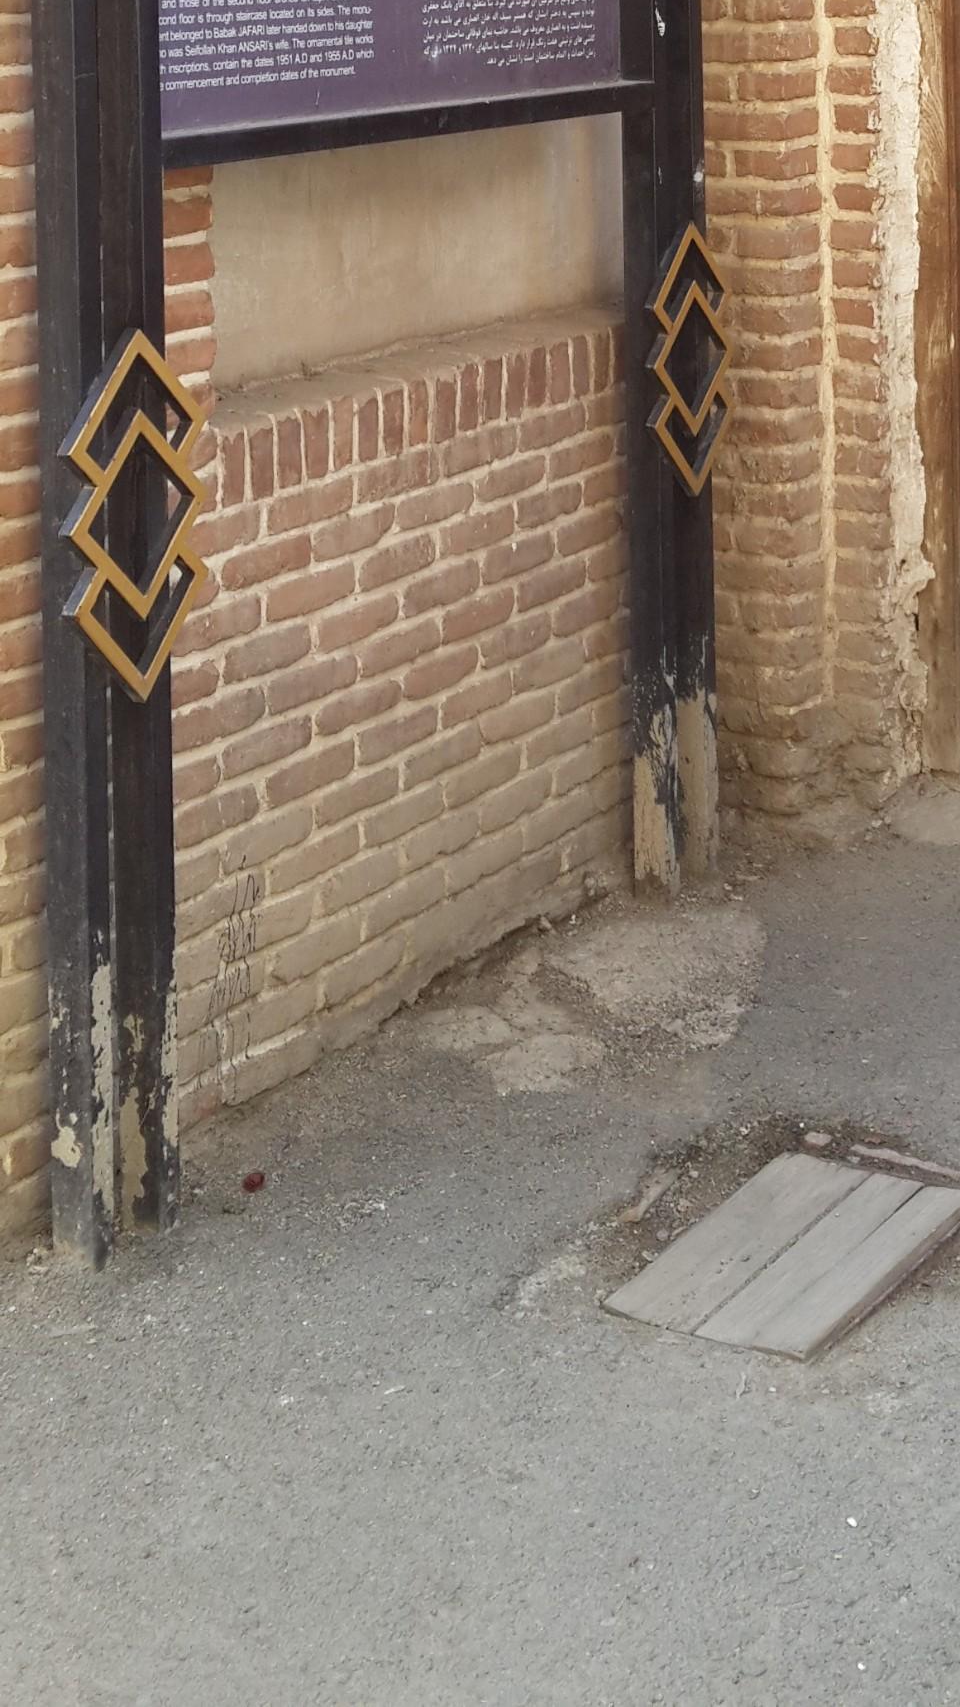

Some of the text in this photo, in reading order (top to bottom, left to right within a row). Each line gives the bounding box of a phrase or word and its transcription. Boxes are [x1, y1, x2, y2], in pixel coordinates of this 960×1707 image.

[159, 14, 176, 25] cond
[179, 14, 196, 24] floor
[206, 12, 234, 25] through
[236, 10, 267, 21] staircase
[269, 8, 294, 19] located
[296, 9, 305, 18] on
[337, 5, 350, 15] The
[170, 29, 204, 43] belonged
[213, 27, 236, 38] Babak
[238, 25, 265, 36] JAFARI
[266, 24, 281, 34] later
[282, 23, 307, 34] handed
[309, 22, 326, 32] down
[335, 21, 344, 31] his
[345, 20, 373, 32] daughter
[168, 48, 183, 57] was
[218, 43, 237, 54] Khan
[292, 38, 306, 49] The
[307, 36, 343, 48] ornamental
[355, 35, 374, 44] works
[213, 59, 239, 70] contain
[241, 58, 252, 68] the
[254, 56, 274, 67] dates
[309, 52, 322, 63] and
[356, 48, 374, 59] which
[165, 76, 224, 90] commencement
[226, 74, 240, 85] and
[241, 70, 278, 86] completion
[280, 70, 298, 81] dates
[308, 68, 318, 78] the
